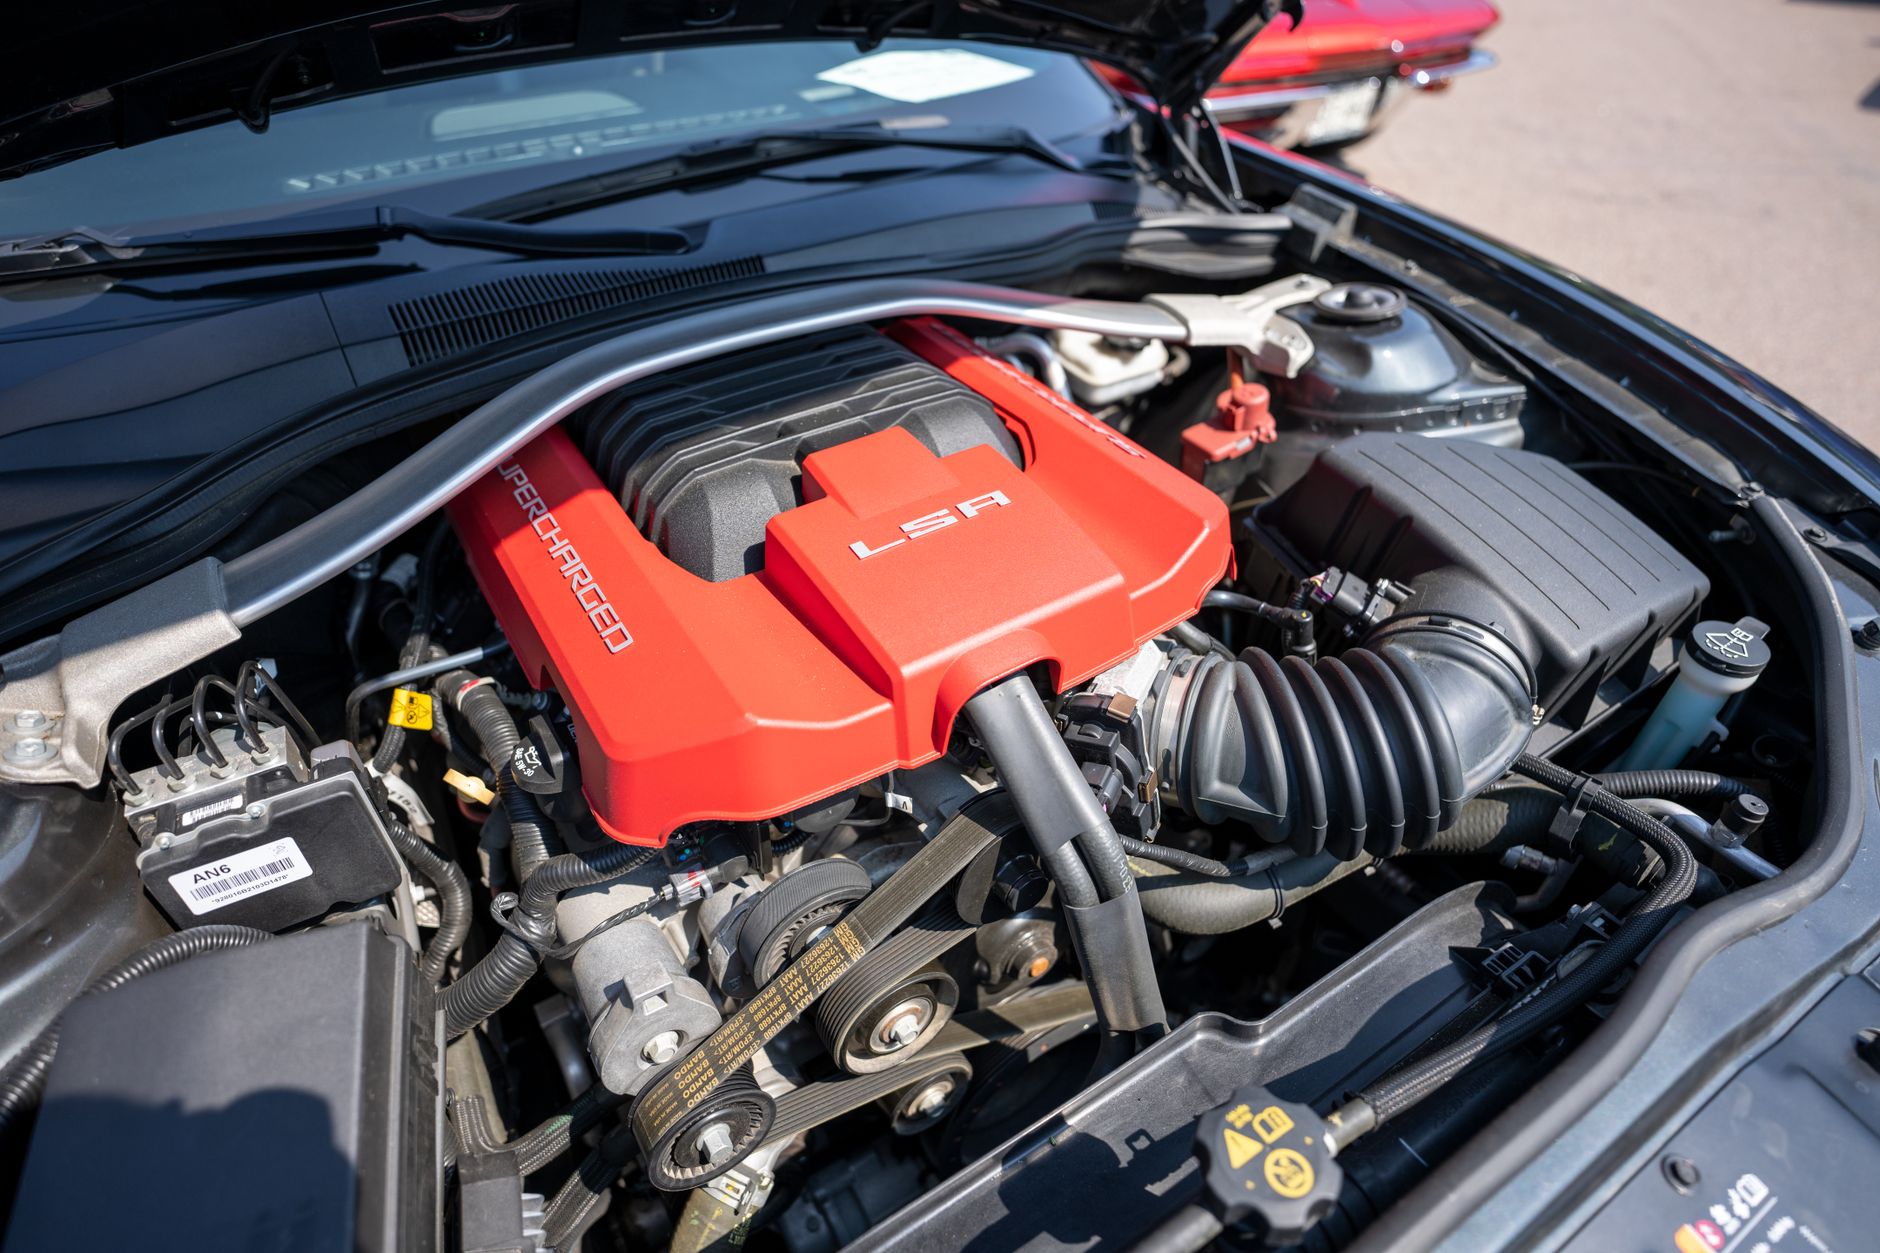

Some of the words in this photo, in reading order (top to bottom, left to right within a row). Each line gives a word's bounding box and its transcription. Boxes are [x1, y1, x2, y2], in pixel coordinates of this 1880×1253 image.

[848, 489, 1012, 561] LSA
[497, 454, 634, 654] UPERCHARGED
[515, 747, 524, 760] SAE
[515, 760, 535, 777] 5W-30
[193, 864, 231, 884] AN6
[832, 922, 849, 938] GM
[838, 928, 854, 946] GM
[799, 936, 832, 968] 12636227
[843, 937, 860, 954] GM
[849, 945, 865, 962] GM
[804, 944, 838, 976] 12636227
[810, 952, 843, 984] 12636227
[778, 967, 798, 987] AAAT
[784, 975, 803, 995] AAAT
[814, 961, 850, 992] 12636227
[748, 986, 776, 1013] 8PK1680
[752, 994, 782, 1021] 8PK1680
[788, 984, 808, 1004] AAAT
[794, 992, 814, 1012] AAAT
[758, 1003, 786, 1030] 8PK1680
[762, 1012, 792, 1040] 8PK1680
[674, 1050, 705, 1079] BANDO
[677, 1058, 709, 1088] BANDO
[682, 1068, 714, 1098] BANDO
[686, 1077, 718, 1108] BANDO
